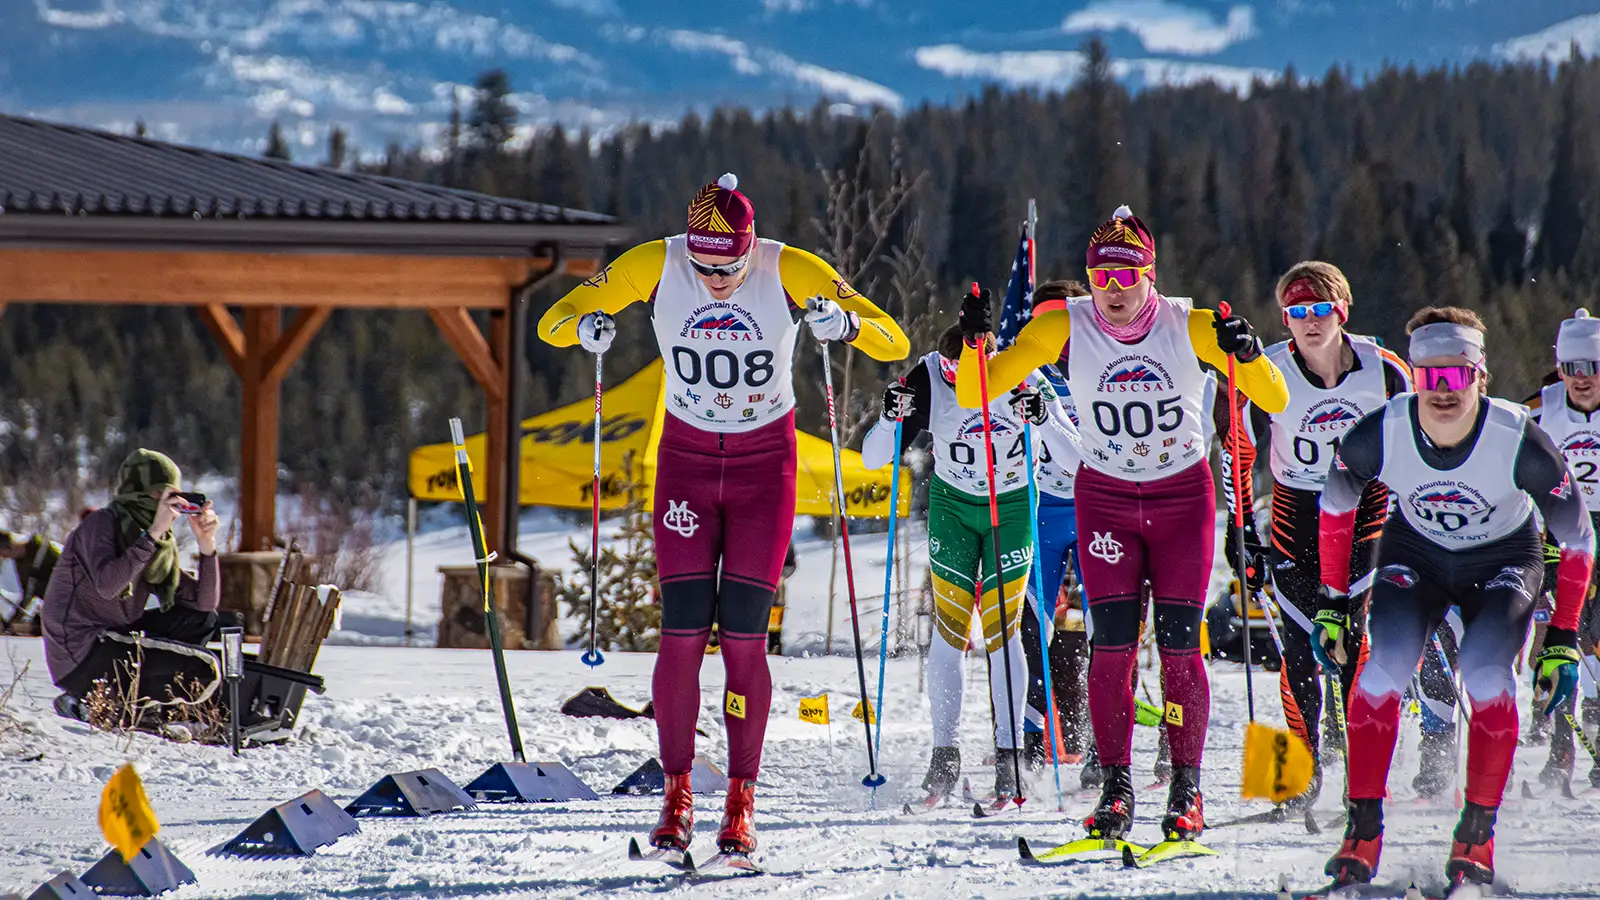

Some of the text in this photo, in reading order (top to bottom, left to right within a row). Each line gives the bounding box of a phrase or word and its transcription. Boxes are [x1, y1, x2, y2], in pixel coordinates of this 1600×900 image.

[680, 315, 695, 338] Rocky
[693, 301, 730, 316] Mountain
[731, 303, 763, 341] Conference
[691, 330, 752, 341] USCSA
[671, 345, 774, 390] 008
[1097, 371, 1110, 392] Rocky
[1106, 354, 1141, 371] Mountain
[1142, 355, 1174, 390] Conference
[1106, 382, 1163, 393] USCSA
[1092, 394, 1184, 438] 005
[1307, 397, 1338, 414] Mountain
[1340, 397, 1366, 418] Conferen
[964, 430, 1012, 440] USSA
[1107, 439, 1123, 455] AF
[1293, 435, 1340, 465] 01
[1416, 480, 1455, 493] Mountain
[1000, 545, 1031, 568] CSU
[1485, 581, 1532, 602] NORDIC
